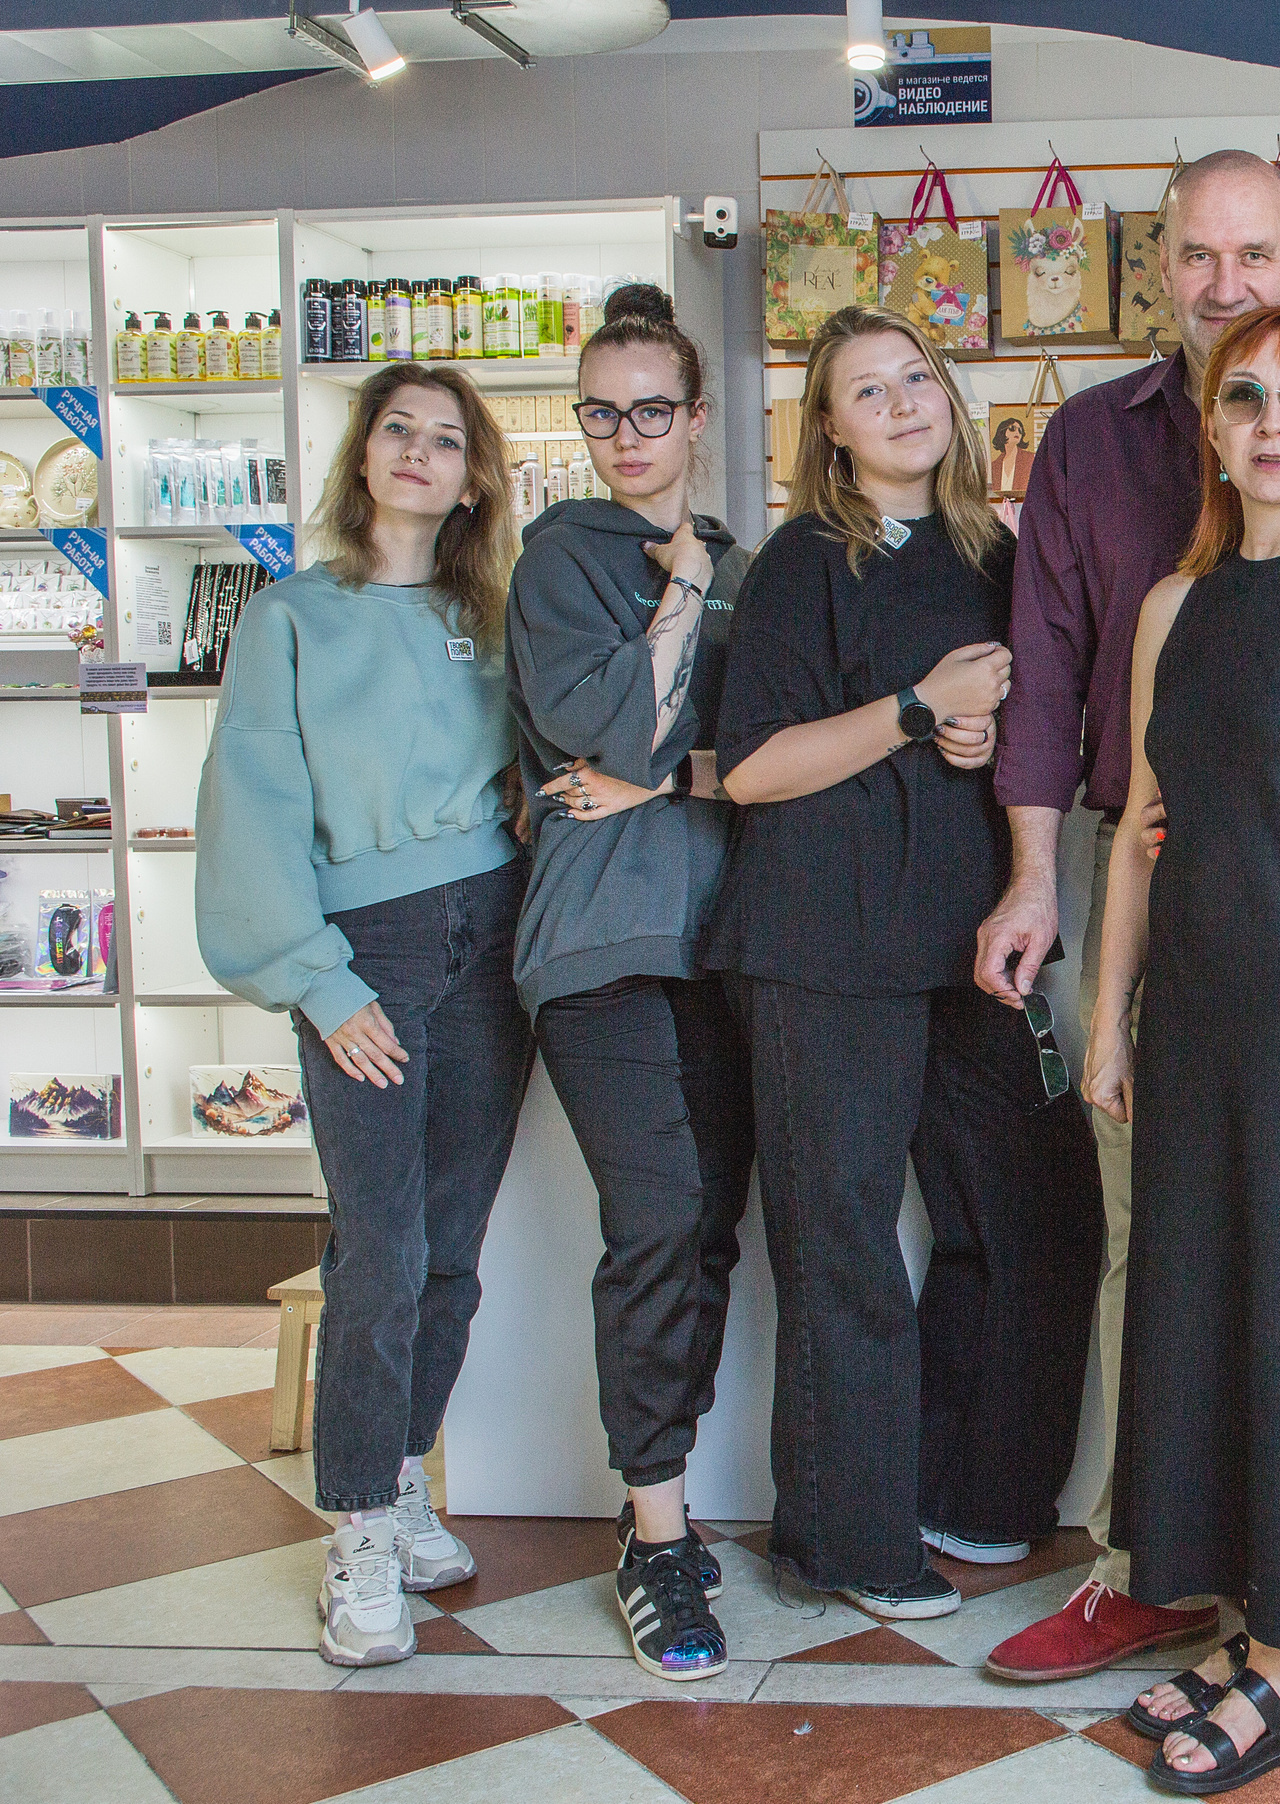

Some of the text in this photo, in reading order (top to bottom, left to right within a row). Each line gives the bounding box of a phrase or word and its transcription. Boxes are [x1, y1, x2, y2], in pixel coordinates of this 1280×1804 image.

[898, 87, 942, 102] ВИДЕО
[906, 76, 950, 85] магазине
[953, 74, 988, 83] ведется
[898, 100, 988, 116] НАБЛЮДЕНИЕ
[55, 401, 88, 437] РАБОТА
[61, 389, 98, 429] РУЧНАЯ
[62, 541, 95, 577] РАБОТА
[68, 530, 105, 570] РУЧНАЯ
[249, 537, 282, 573] РАБОТА
[255, 526, 293, 566] РУЧНАЯ
[55, 916, 64, 964] ПЕТЕРБРГ
[353, 1544, 376, 1554] DEMIX
